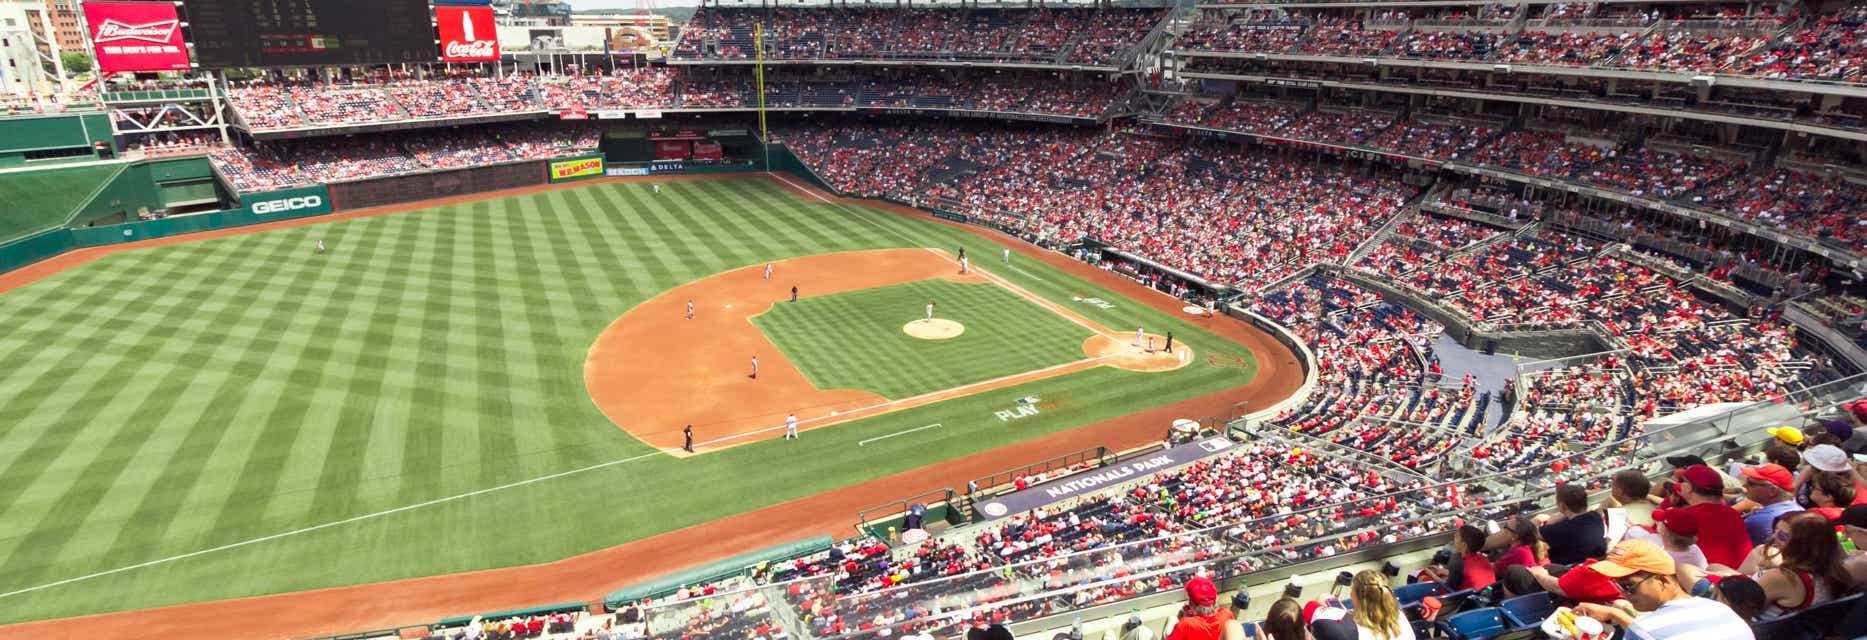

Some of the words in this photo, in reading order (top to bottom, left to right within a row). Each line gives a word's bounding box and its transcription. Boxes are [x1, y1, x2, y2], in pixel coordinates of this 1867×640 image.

[98, 24, 170, 37] Budweiser
[446, 40, 495, 58] Coca-Cola
[251, 195, 322, 214] GEICO
[993, 403, 1040, 422] PLAY
[1046, 466, 1135, 497] NATIONALS
[1133, 455, 1175, 474] PARK
